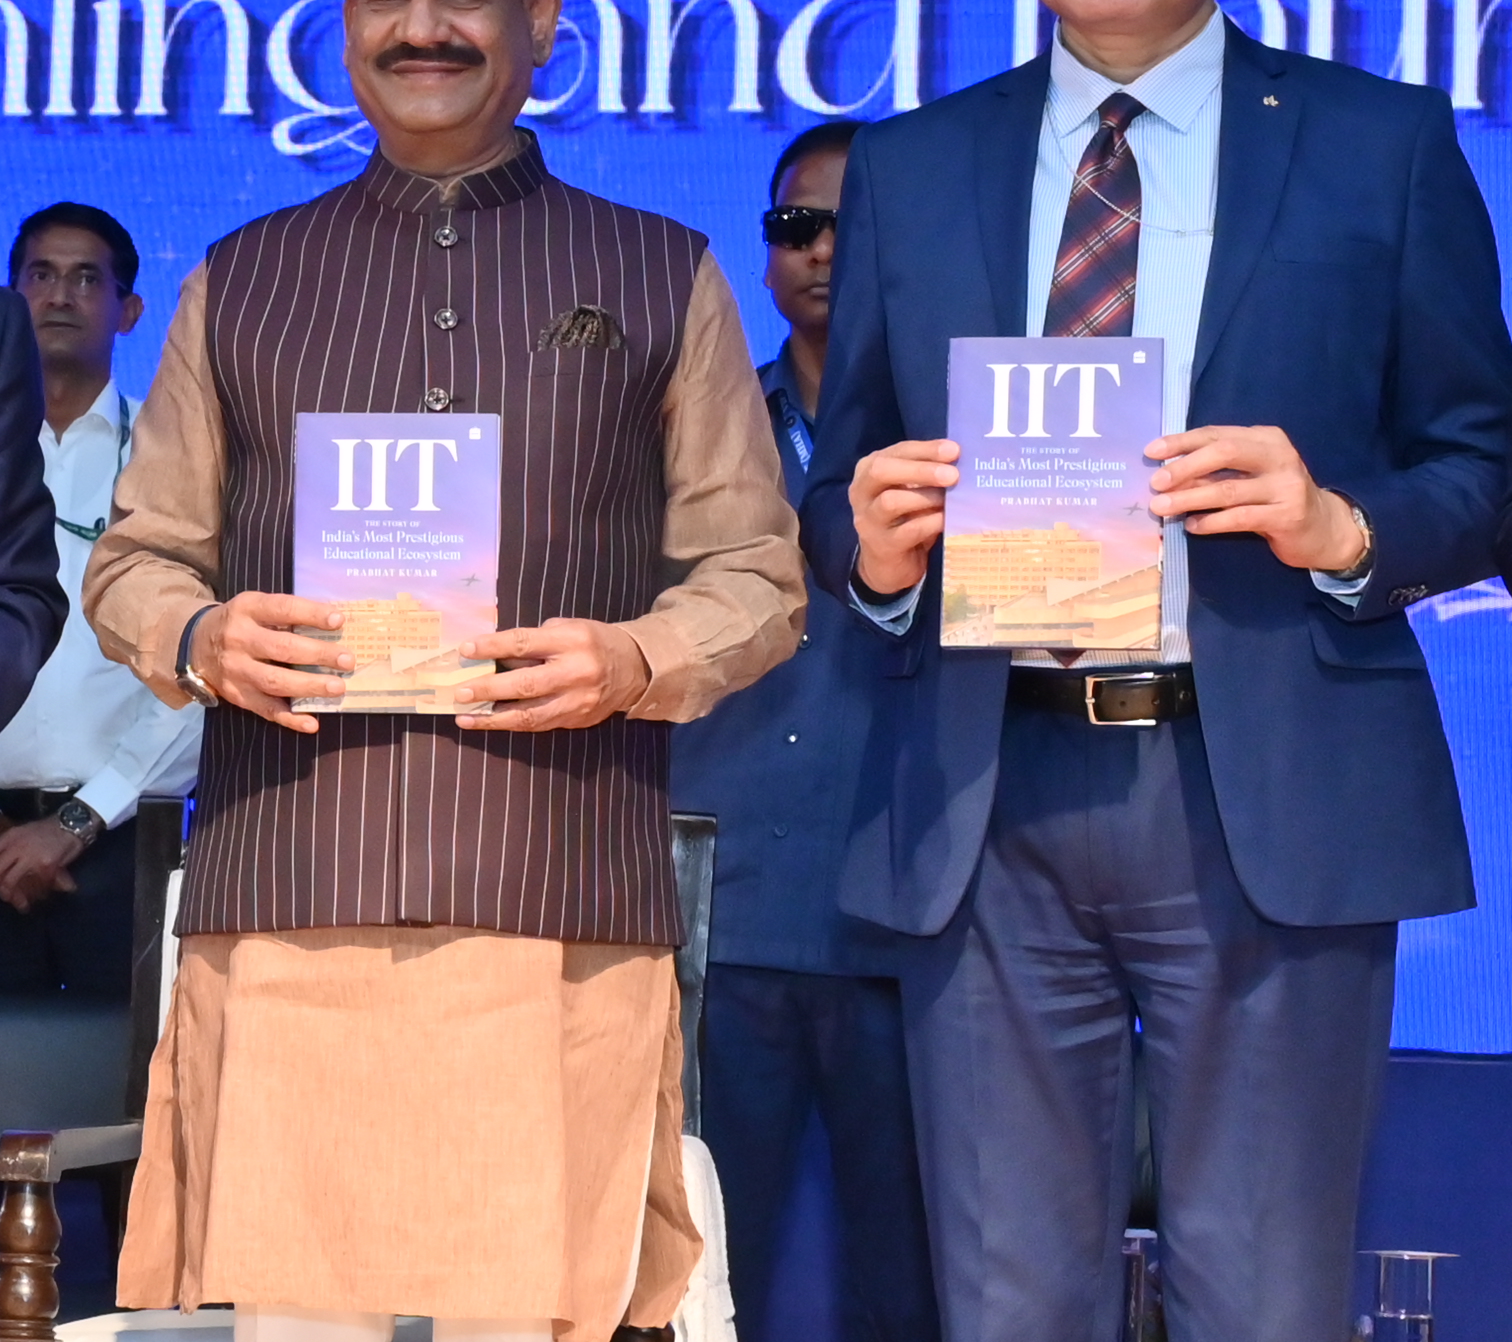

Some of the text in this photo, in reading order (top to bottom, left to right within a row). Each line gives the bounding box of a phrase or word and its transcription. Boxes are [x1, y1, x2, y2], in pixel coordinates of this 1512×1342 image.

[984, 364, 1121, 437] IIT
[1018, 458, 1051, 470] Most
[1054, 458, 1126, 473] Prestigious
[330, 439, 458, 511] IIT
[976, 475, 1123, 491] Educational Ecosystem
[1001, 497, 1097, 506] PRABHAT KUMAR
[363, 531, 393, 543] Most
[397, 531, 463, 546] Prestigious
[324, 547, 461, 563] Educational Ecosystem
[347, 569, 438, 577] PRABHAT KUMAR
